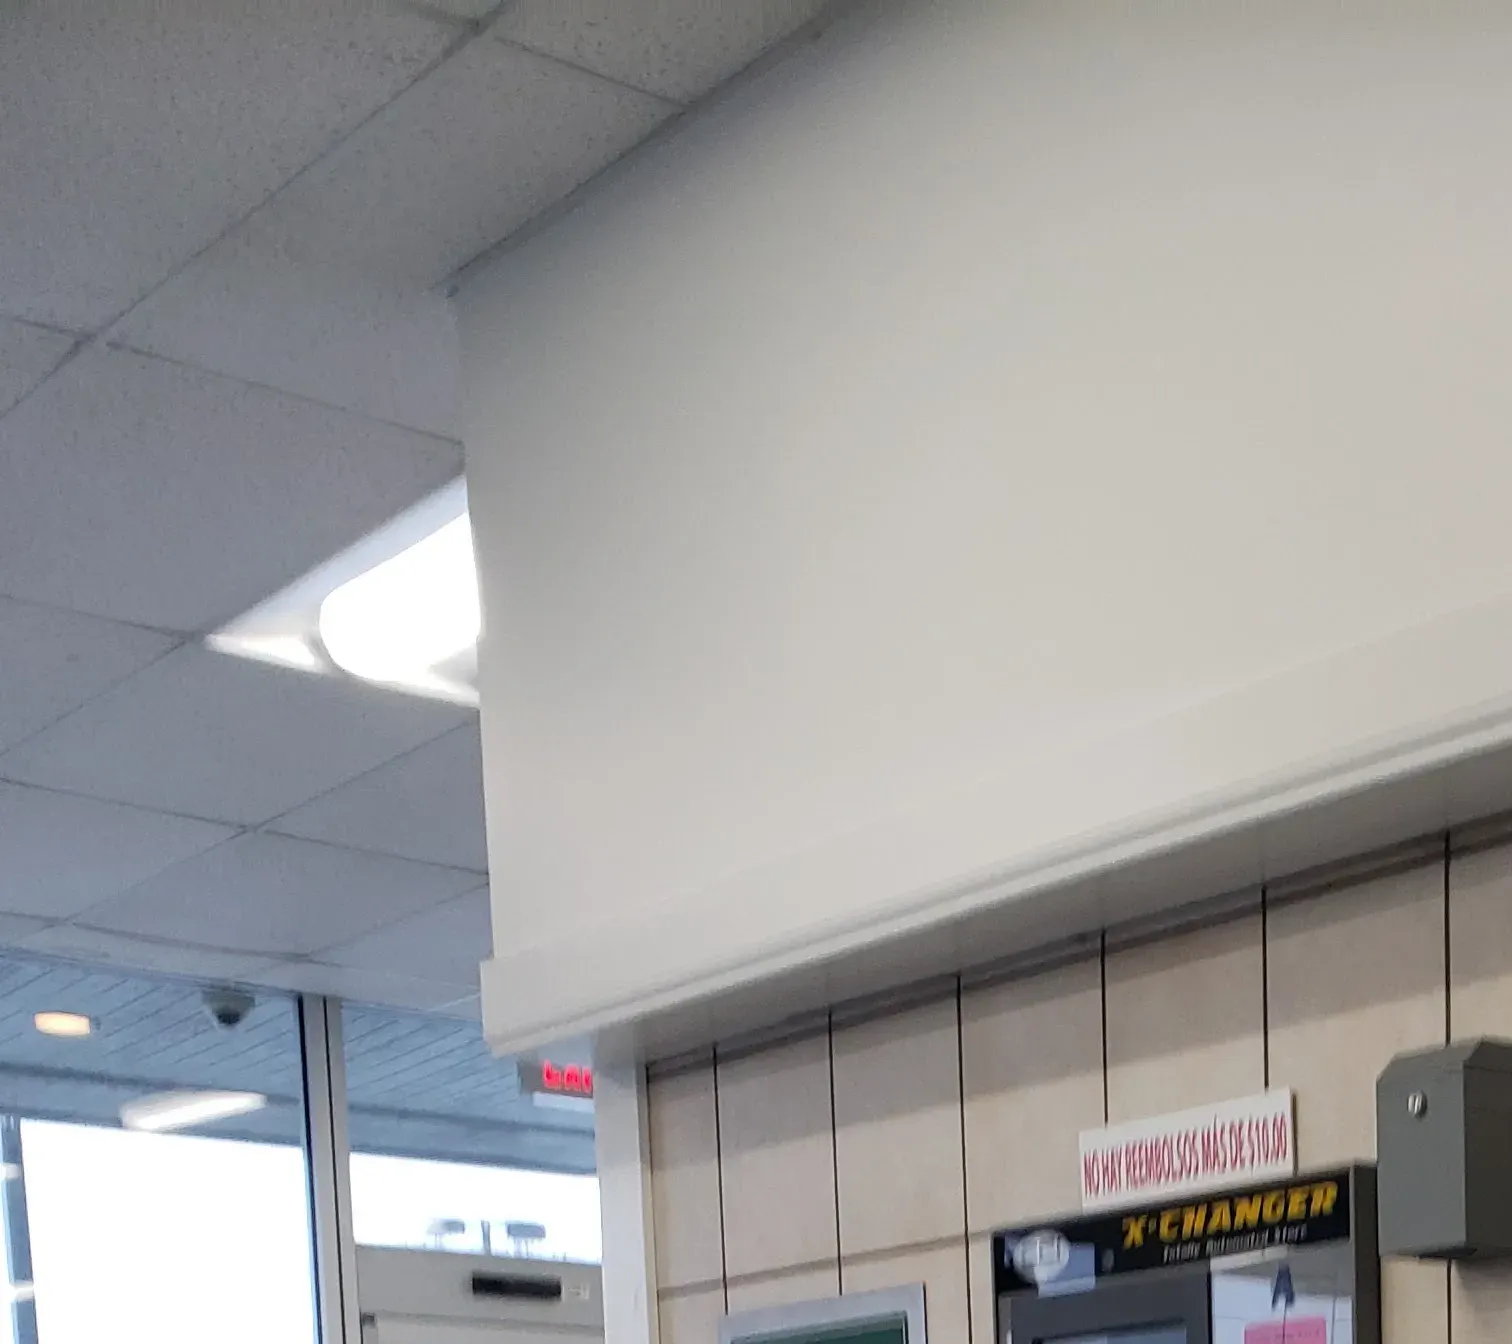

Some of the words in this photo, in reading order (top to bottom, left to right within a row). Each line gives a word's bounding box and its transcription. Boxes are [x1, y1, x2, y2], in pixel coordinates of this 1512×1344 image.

[1083, 1149, 1100, 1196] NO
[1102, 1144, 1123, 1194] HAY
[1126, 1127, 1200, 1191] REEMBOLSOS
[1201, 1113, 1227, 1176] MÁS
[1229, 1117, 1246, 1172] DE
[1248, 1111, 1288, 1173] $10.00
[1271, 1264, 1296, 1311] A
